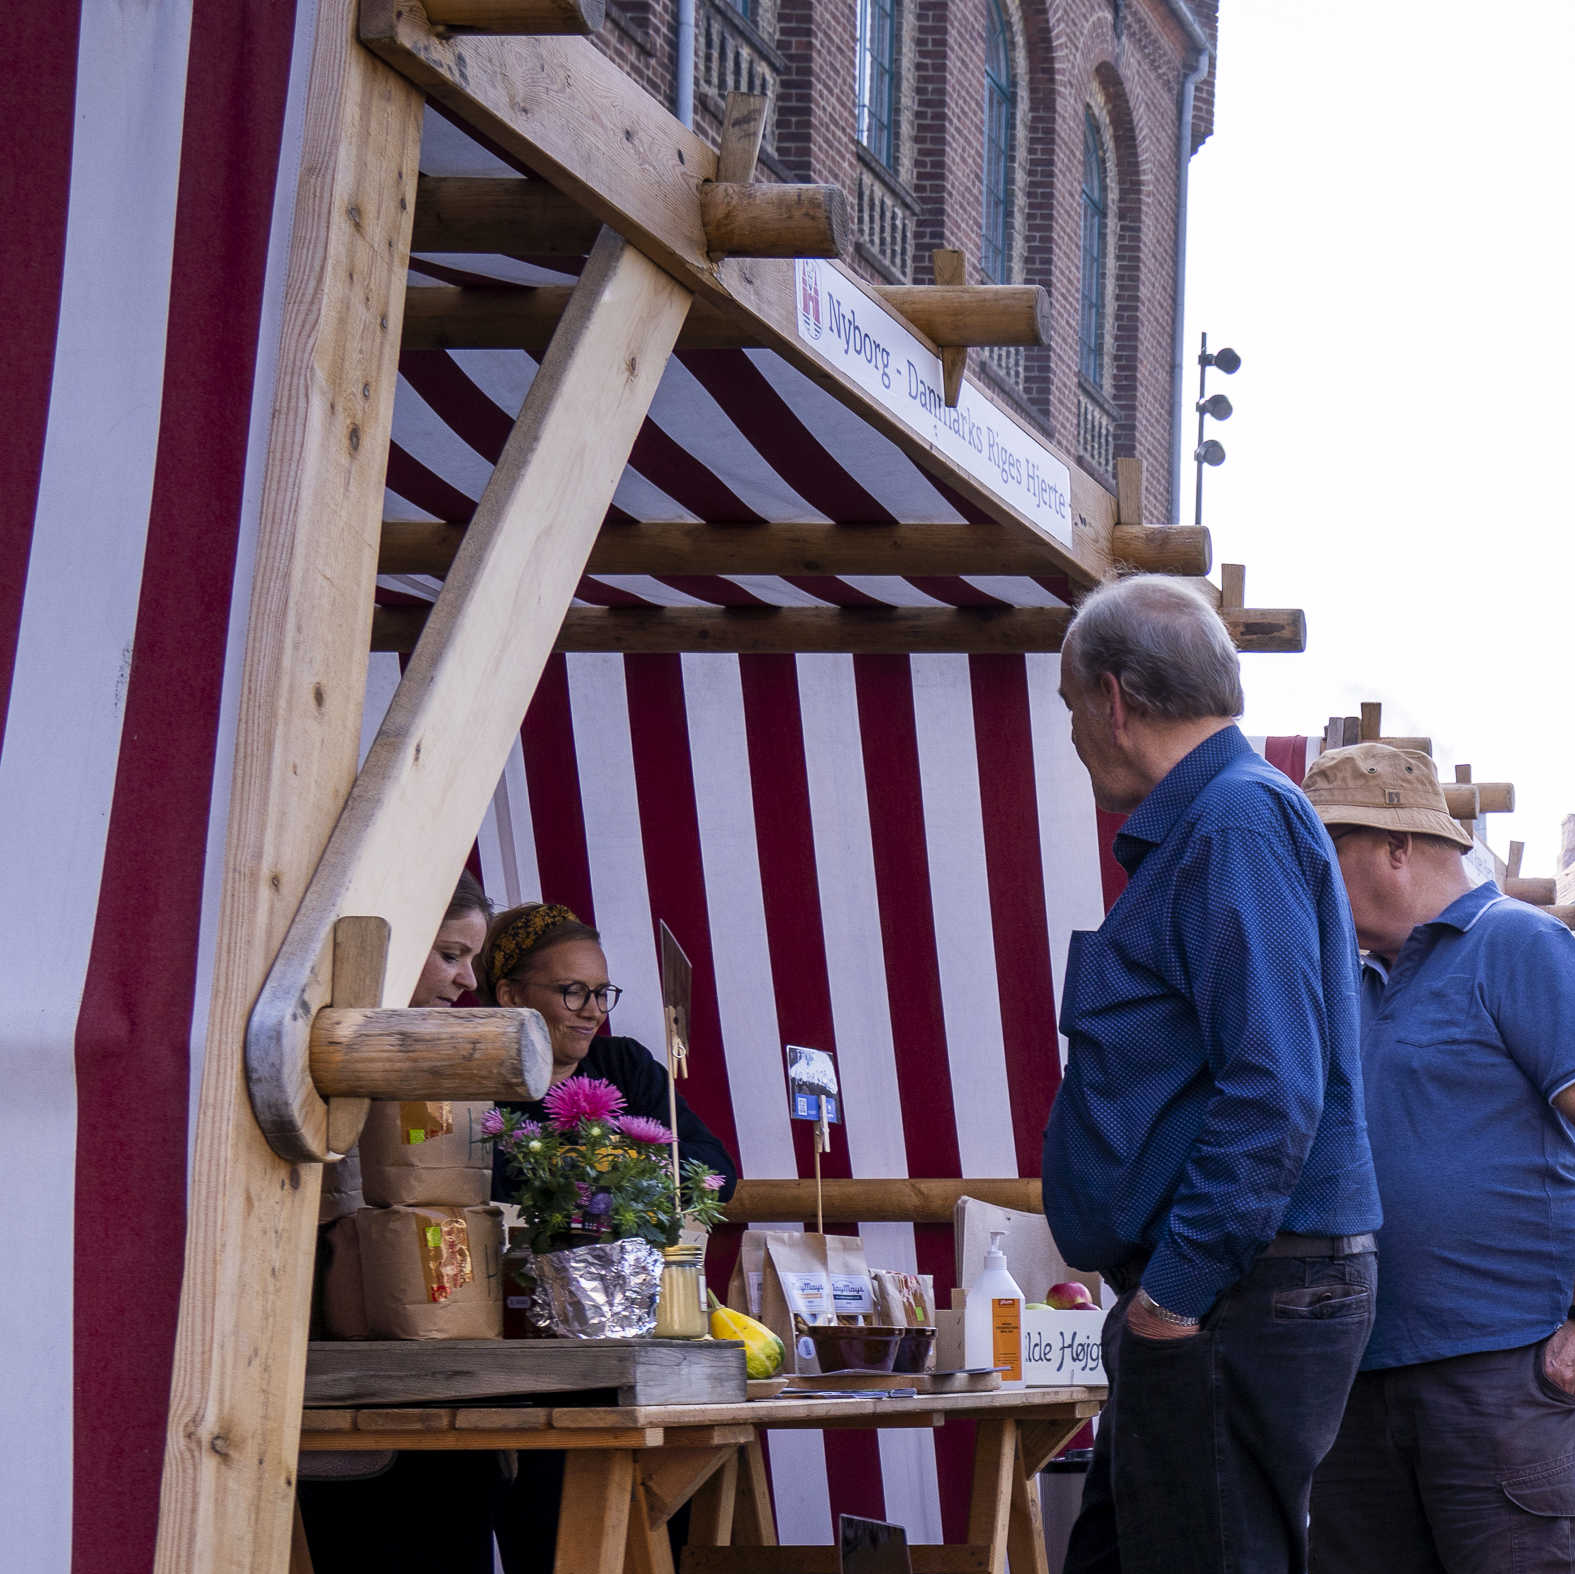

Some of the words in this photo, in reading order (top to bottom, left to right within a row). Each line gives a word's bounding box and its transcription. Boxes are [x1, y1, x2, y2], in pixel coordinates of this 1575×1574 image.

[827, 292, 891, 390] Nyborg
[986, 426, 1022, 484] Riges
[1025, 459, 1067, 519] Hjerte
